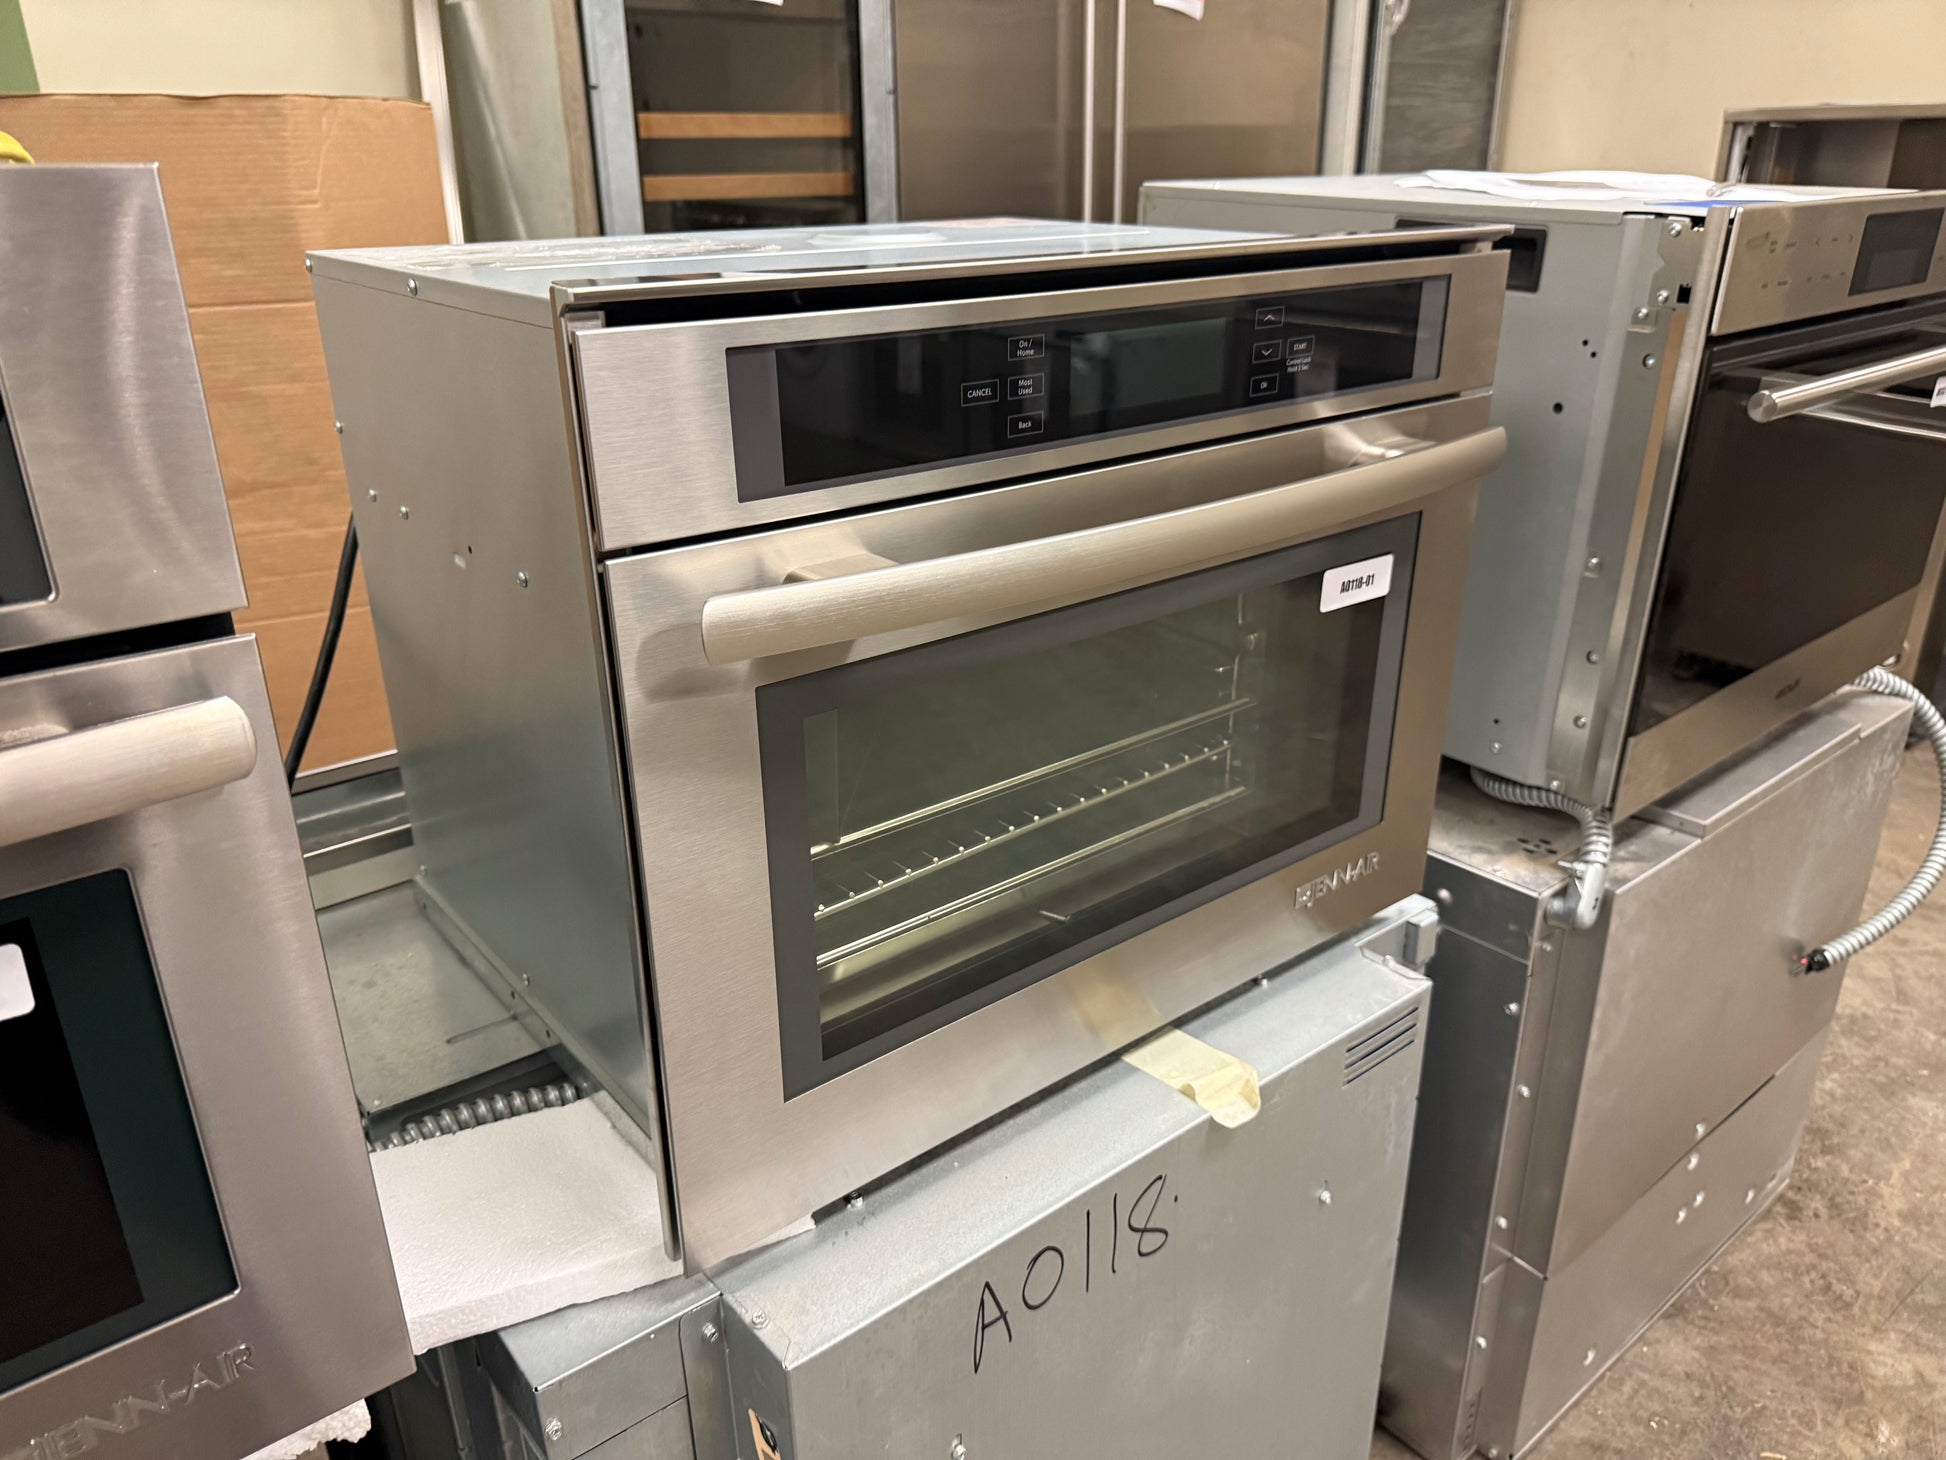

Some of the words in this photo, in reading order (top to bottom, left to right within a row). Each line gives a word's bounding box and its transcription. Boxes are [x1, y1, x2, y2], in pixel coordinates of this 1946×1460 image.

[1018, 340, 1028, 349] On
[1293, 342, 1308, 351] START
[1017, 348, 1035, 357] Home
[1018, 378, 1033, 387] Most
[967, 387, 992, 398] CANCEL
[1018, 386, 1033, 395] Used
[1018, 421, 1032, 430] Back
[1340, 573, 1375, 594] A0118-01
